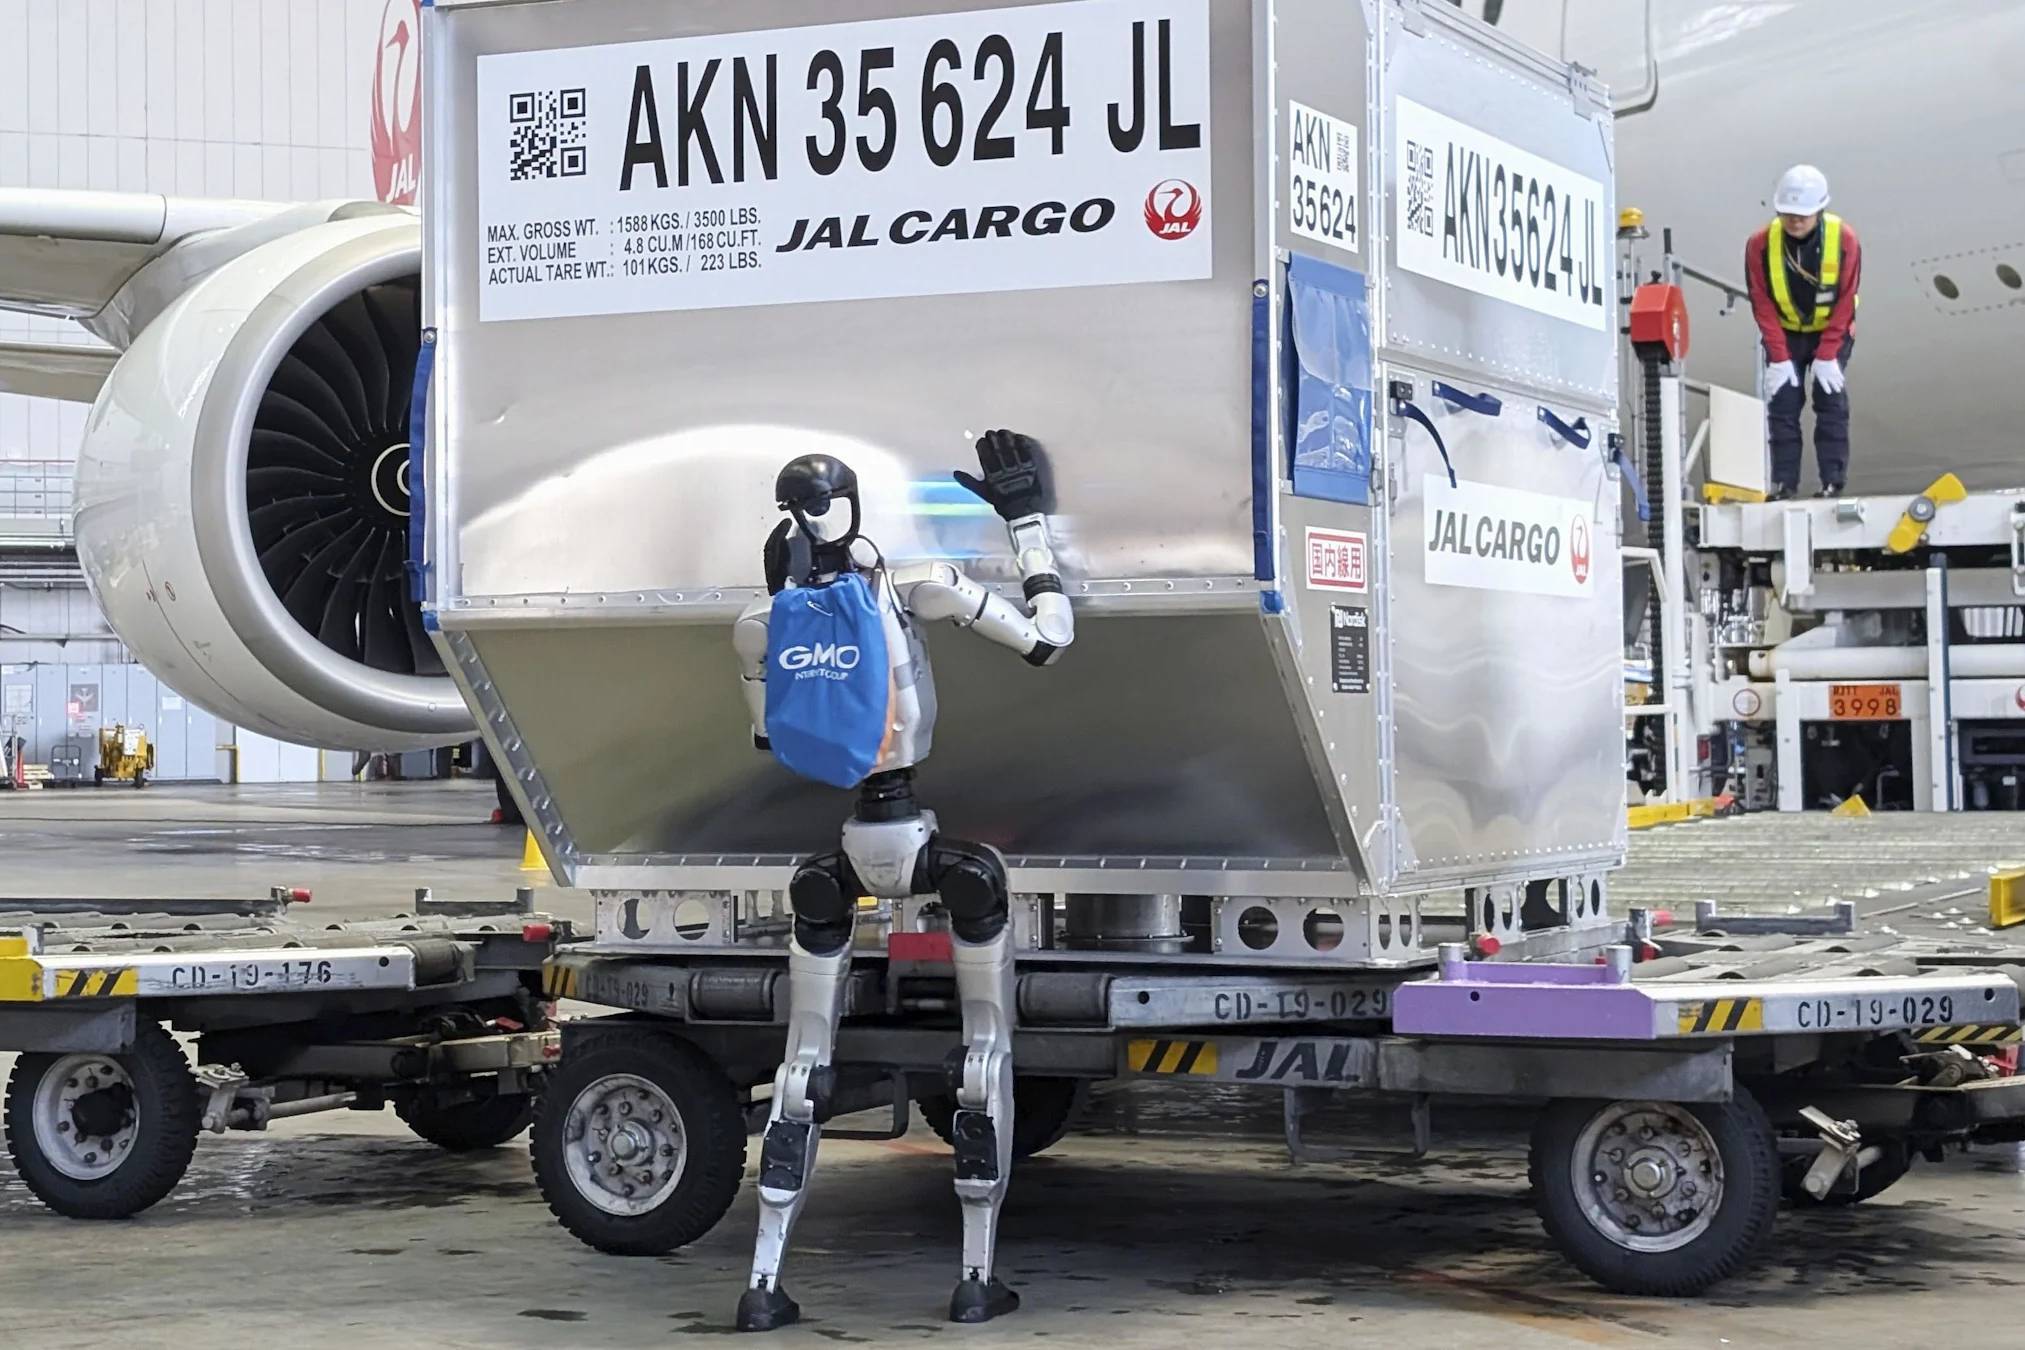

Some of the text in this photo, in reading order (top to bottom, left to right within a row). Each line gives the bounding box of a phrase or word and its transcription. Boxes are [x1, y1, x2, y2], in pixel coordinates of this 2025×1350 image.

[618, 53, 778, 192] AKN
[1106, 18, 1201, 154] JL
[1292, 109, 1331, 174] AKN
[384, 152, 417, 204] JAL
[487, 224, 519, 242] MAX.
[523, 219, 571, 240] GROSS
[574, 218, 599, 236] WT.
[617, 215, 648, 233] 1588
[651, 212, 683, 231] KGS.
[694, 209, 725, 228] 3500
[730, 207, 761, 225] LBS.
[775, 197, 1116, 253] JAL CARGO
[1292, 174, 1356, 244] 35624
[1158, 221, 1191, 235] JAL
[487, 246, 516, 264] EXT.
[519, 241, 577, 262] VOLUME
[624, 237, 644, 255] 4.8
[648, 234, 683, 253] CU.M
[716, 229, 761, 248] CU.FT.
[488, 265, 543, 285] ACTUAL
[546, 262, 582, 281] TARE
[623, 258, 645, 277] 101
[648, 256, 683, 275] KGS.
[700, 253, 725, 271] 223
[729, 251, 762, 270] LBS.
[1428, 508, 1561, 566] JAL CARGO
[1311, 542, 1362, 579] 国内線用
[778, 642, 860, 670] GMO
[1833, 698, 1897, 716] 3998
[172, 960, 332, 989] CD-19-176
[1214, 988, 1388, 1020] CD-19-029
[1797, 995, 1954, 1028] CD-19-029
[1235, 1041, 1361, 1082] JAL
